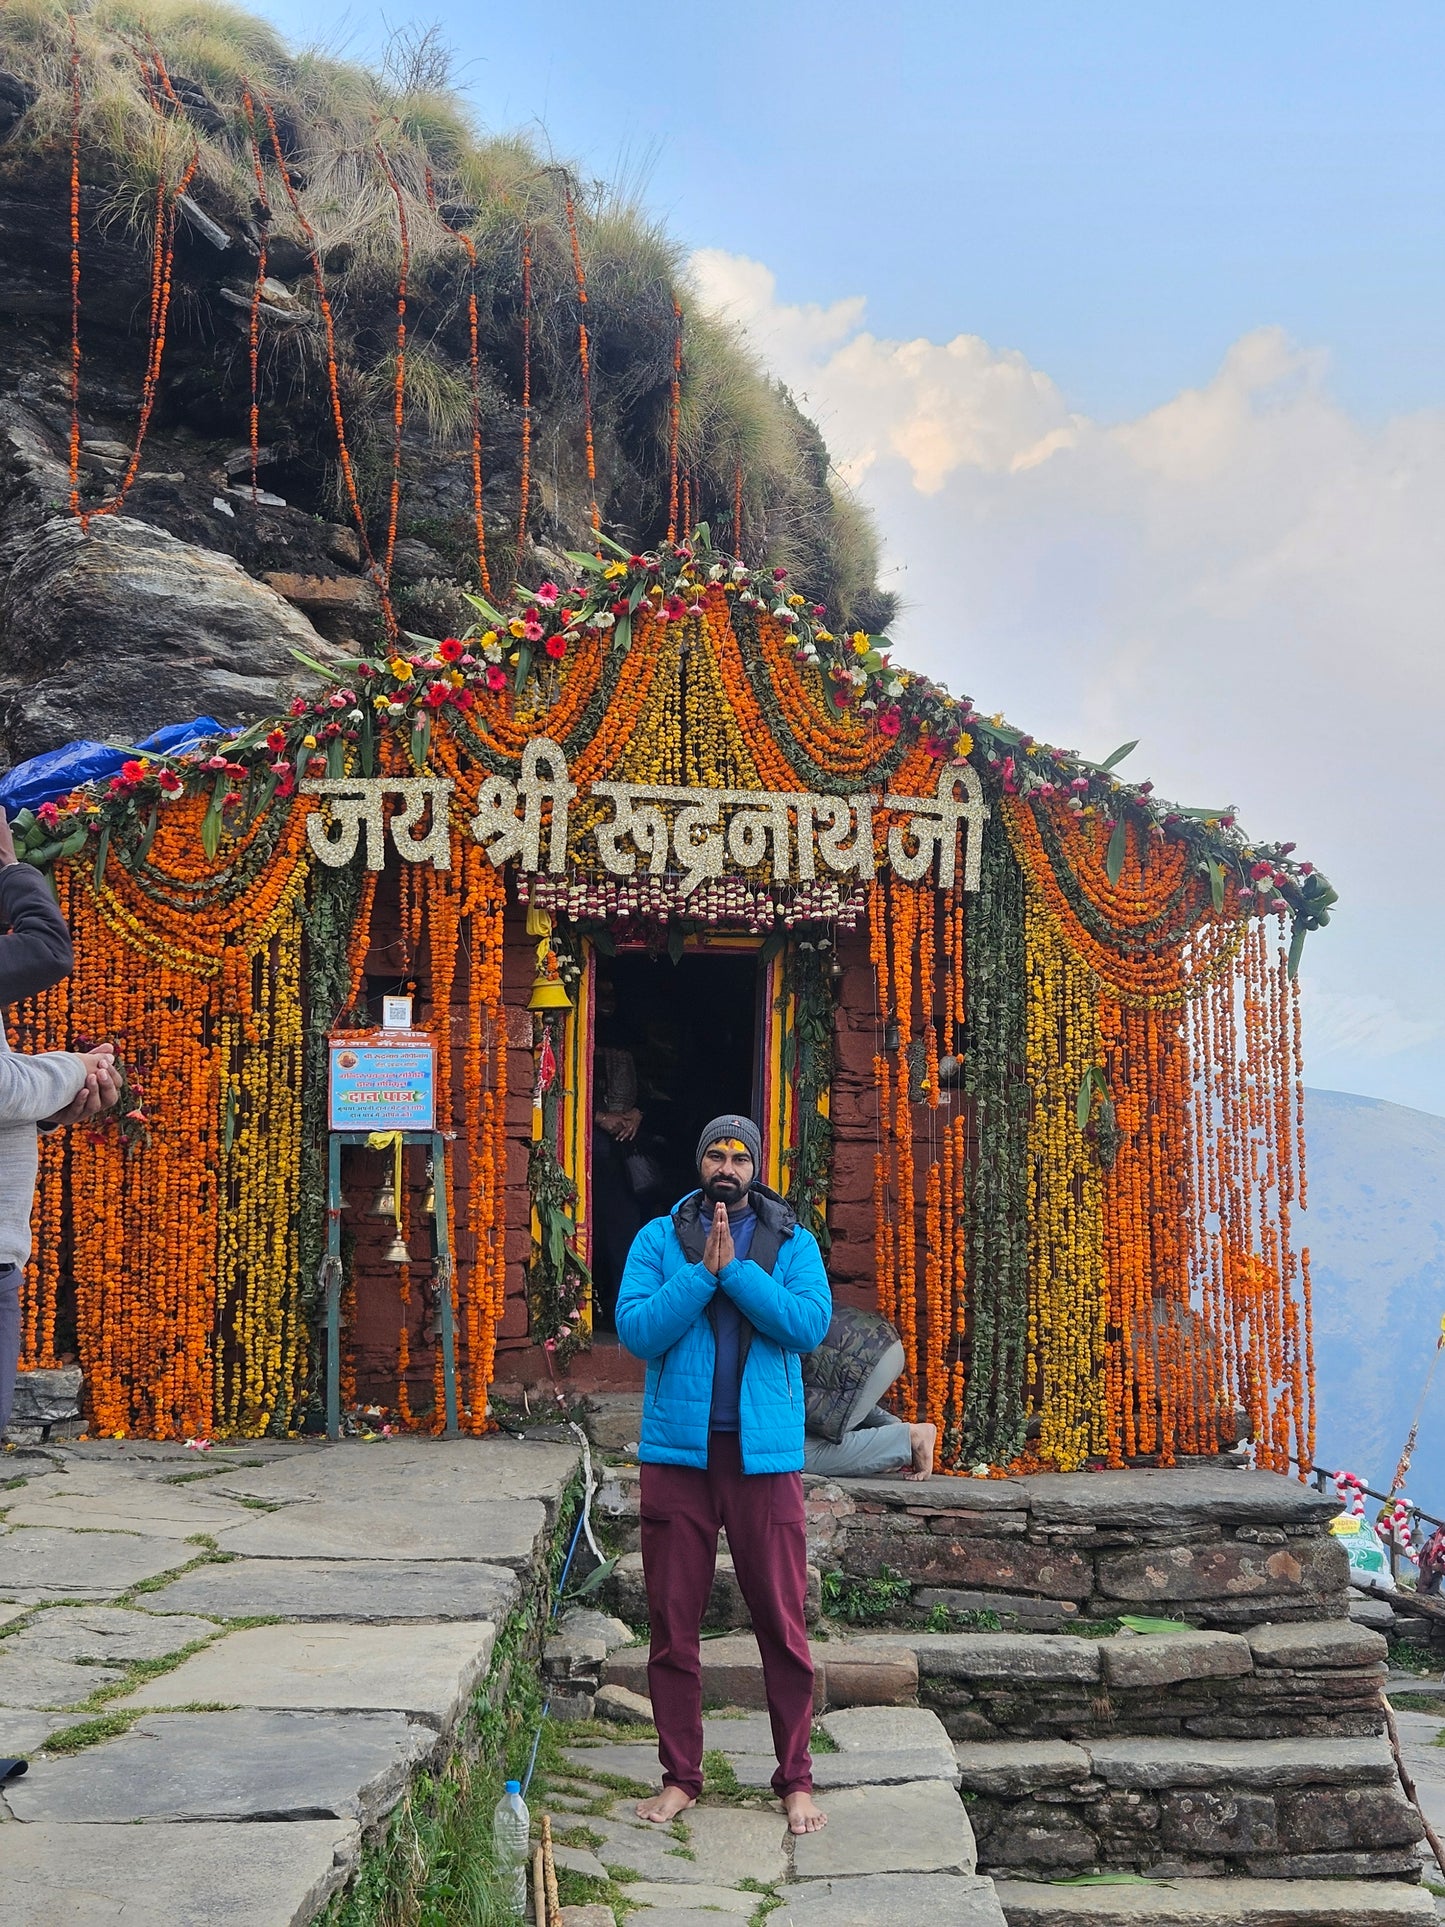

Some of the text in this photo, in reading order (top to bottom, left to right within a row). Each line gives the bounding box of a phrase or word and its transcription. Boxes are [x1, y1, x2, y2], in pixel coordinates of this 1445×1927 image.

[299, 777, 455, 871] जय
[471, 737, 577, 873] श्री
[883, 763, 990, 892] जी
[348, 1090, 415, 1102] दान पात्र
